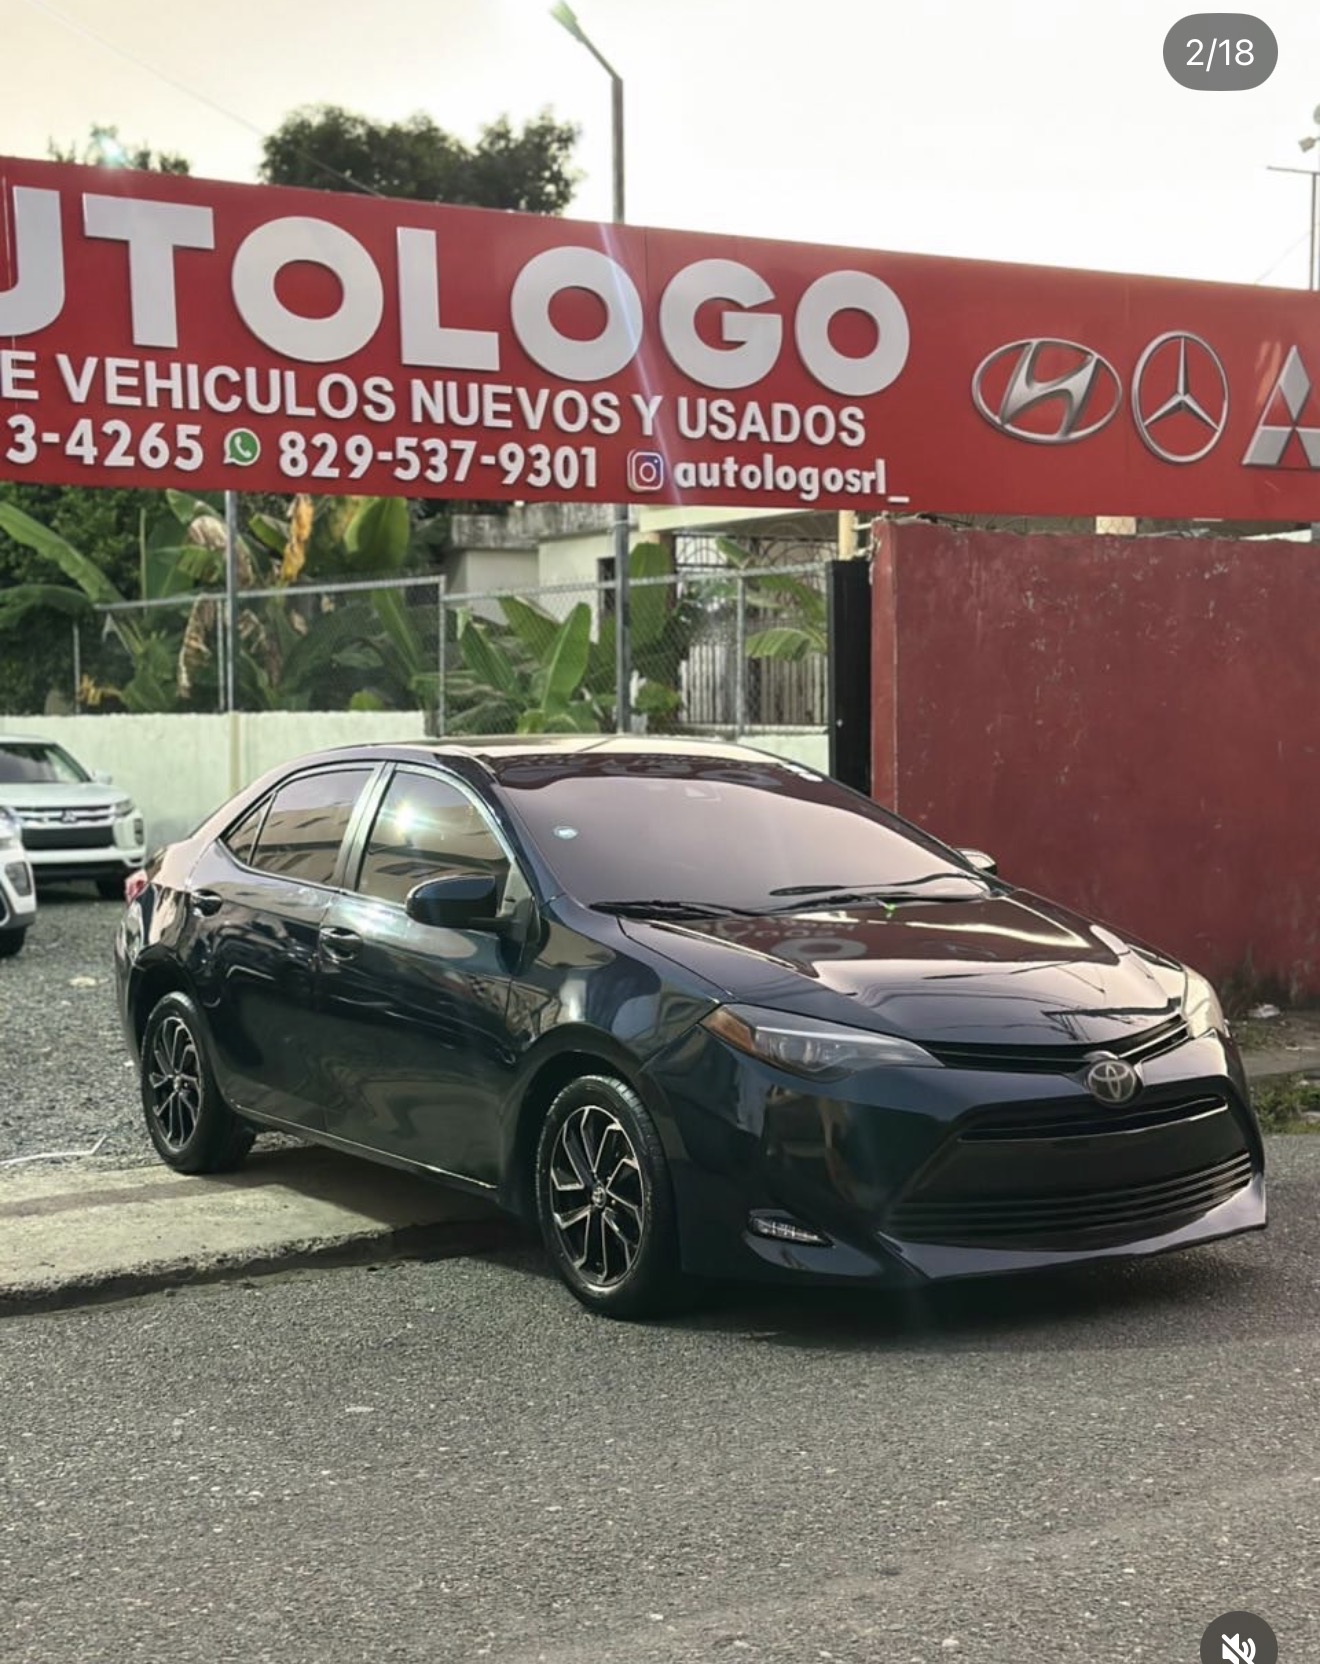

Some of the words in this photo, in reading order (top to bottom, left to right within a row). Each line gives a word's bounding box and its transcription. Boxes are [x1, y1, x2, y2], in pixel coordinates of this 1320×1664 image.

[55, 353, 396, 425] VEHICULOS
[410, 379, 621, 435] NUEVOS
[631, 393, 664, 436] Y
[677, 396, 867, 447] USADOS
[5, 413, 204, 471] 3-4265
[278, 430, 598, 488] 829-537-9301
